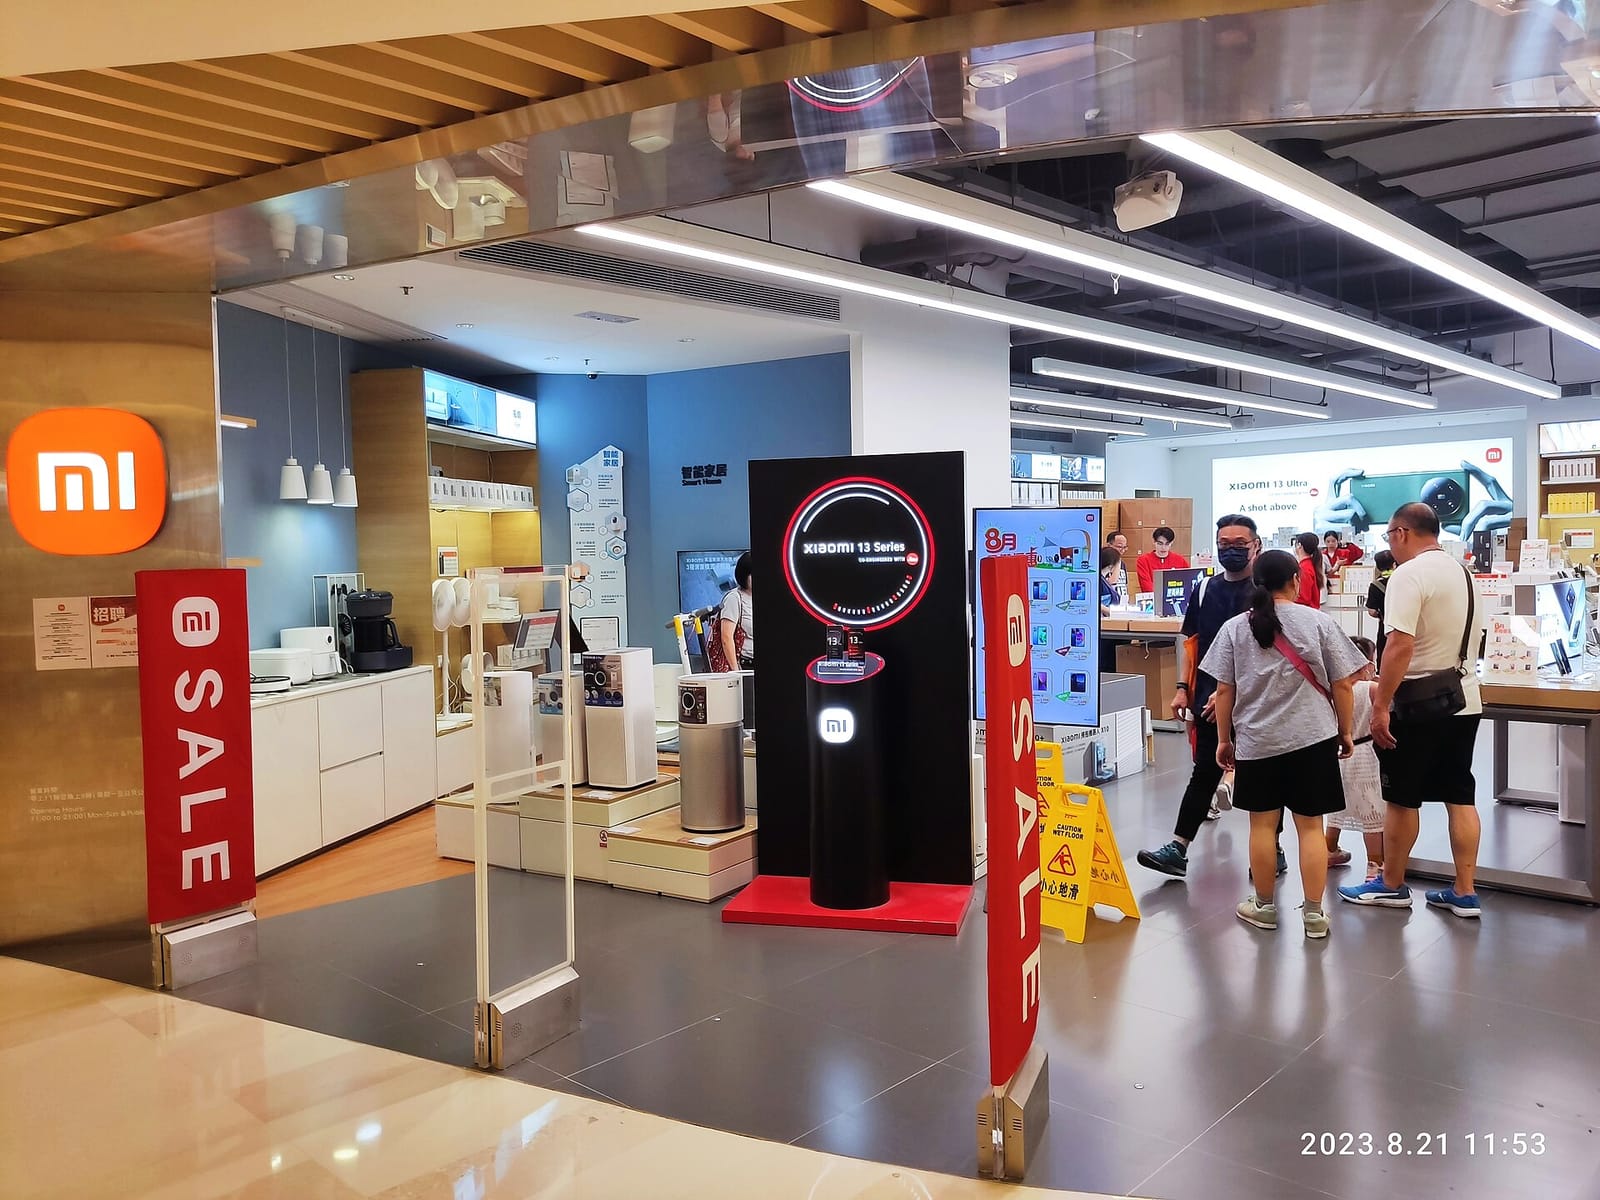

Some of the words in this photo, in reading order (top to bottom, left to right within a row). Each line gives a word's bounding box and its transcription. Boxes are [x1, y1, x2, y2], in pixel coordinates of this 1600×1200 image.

[681, 463, 728, 479] 智能家居
[1273, 480, 1284, 488] 13
[1286, 479, 1309, 488] Ultra
[1239, 504, 1247, 512] A
[1248, 503, 1268, 512] shot
[1269, 503, 1298, 511] above
[857, 542, 871, 553] 13
[873, 541, 906, 553] Series
[93, 607, 126, 623] 招聘
[174, 668, 232, 890] SALE
[1053, 829, 1064, 837] WET
[1065, 831, 1084, 840] FLOOR
[1056, 824, 1082, 833] CAUTION
[1011, 697, 1041, 1023] SALE
[1040, 878, 1079, 900] 小心地滑
